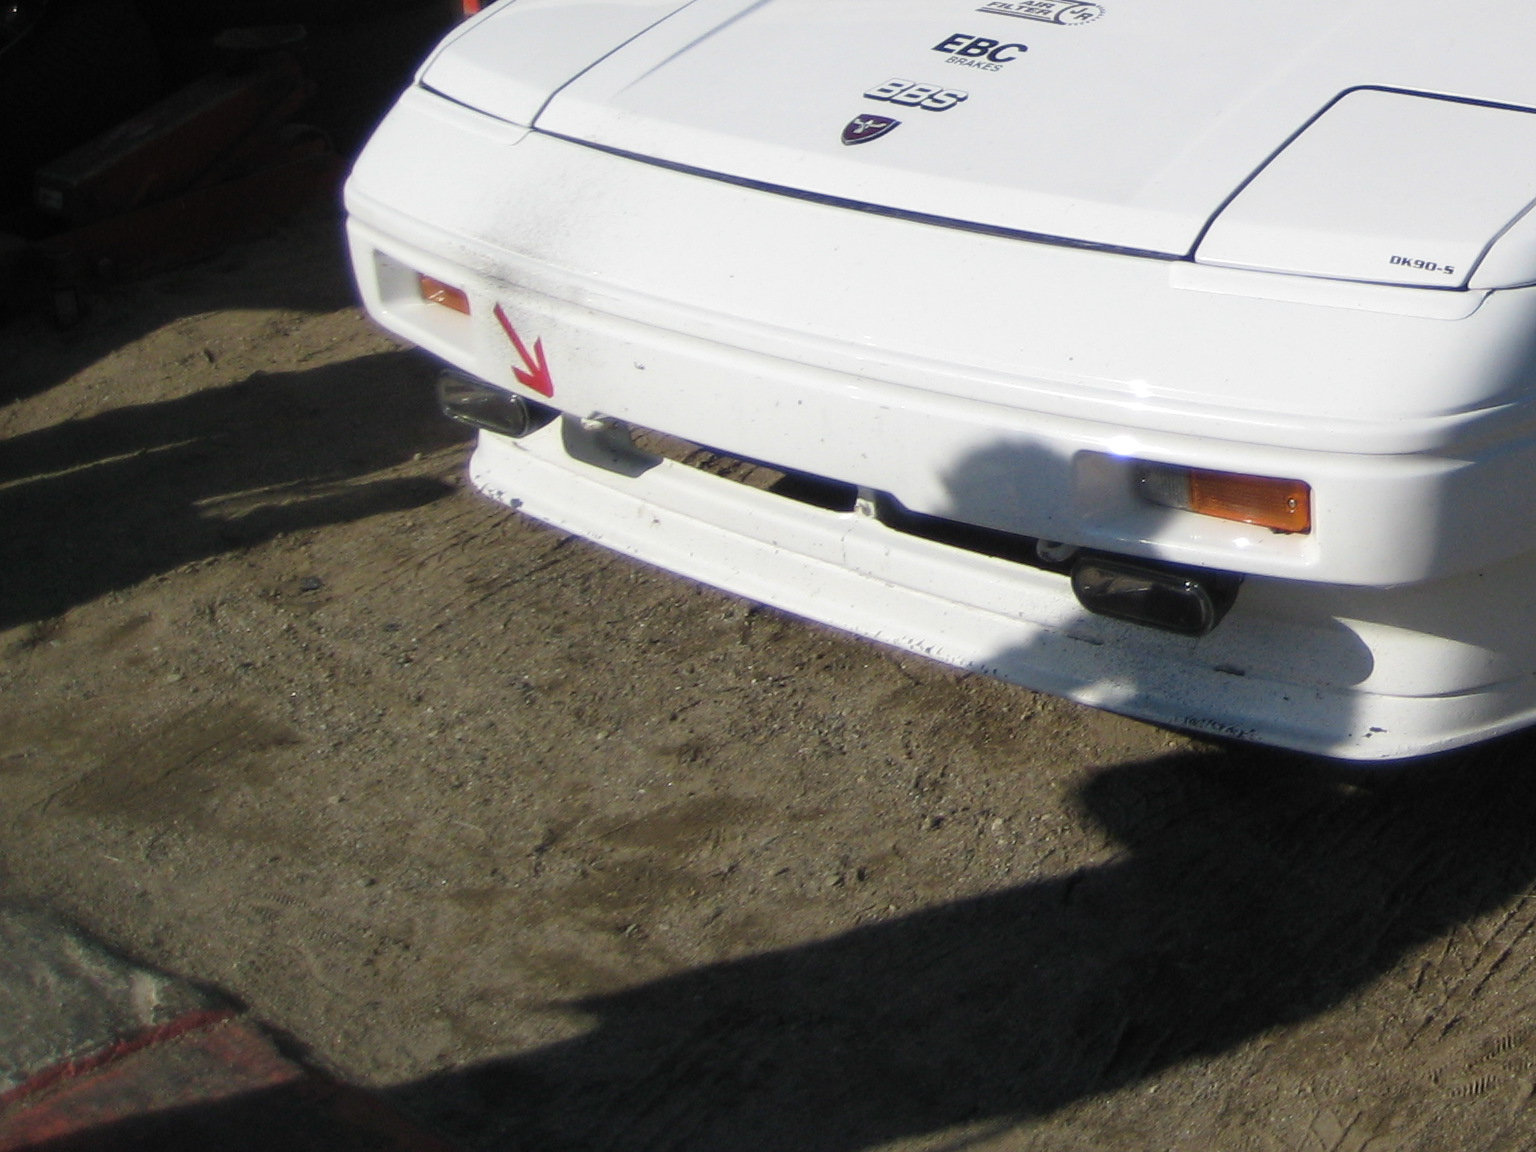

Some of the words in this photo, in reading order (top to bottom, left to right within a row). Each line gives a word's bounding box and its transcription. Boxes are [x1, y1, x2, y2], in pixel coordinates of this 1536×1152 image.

[986, 0, 1052, 17] FILTER
[1020, 0, 1056, 9] AIR
[931, 33, 1029, 63] EBC
[945, 55, 1004, 73] BRAKES
[863, 77, 969, 112] BBS
